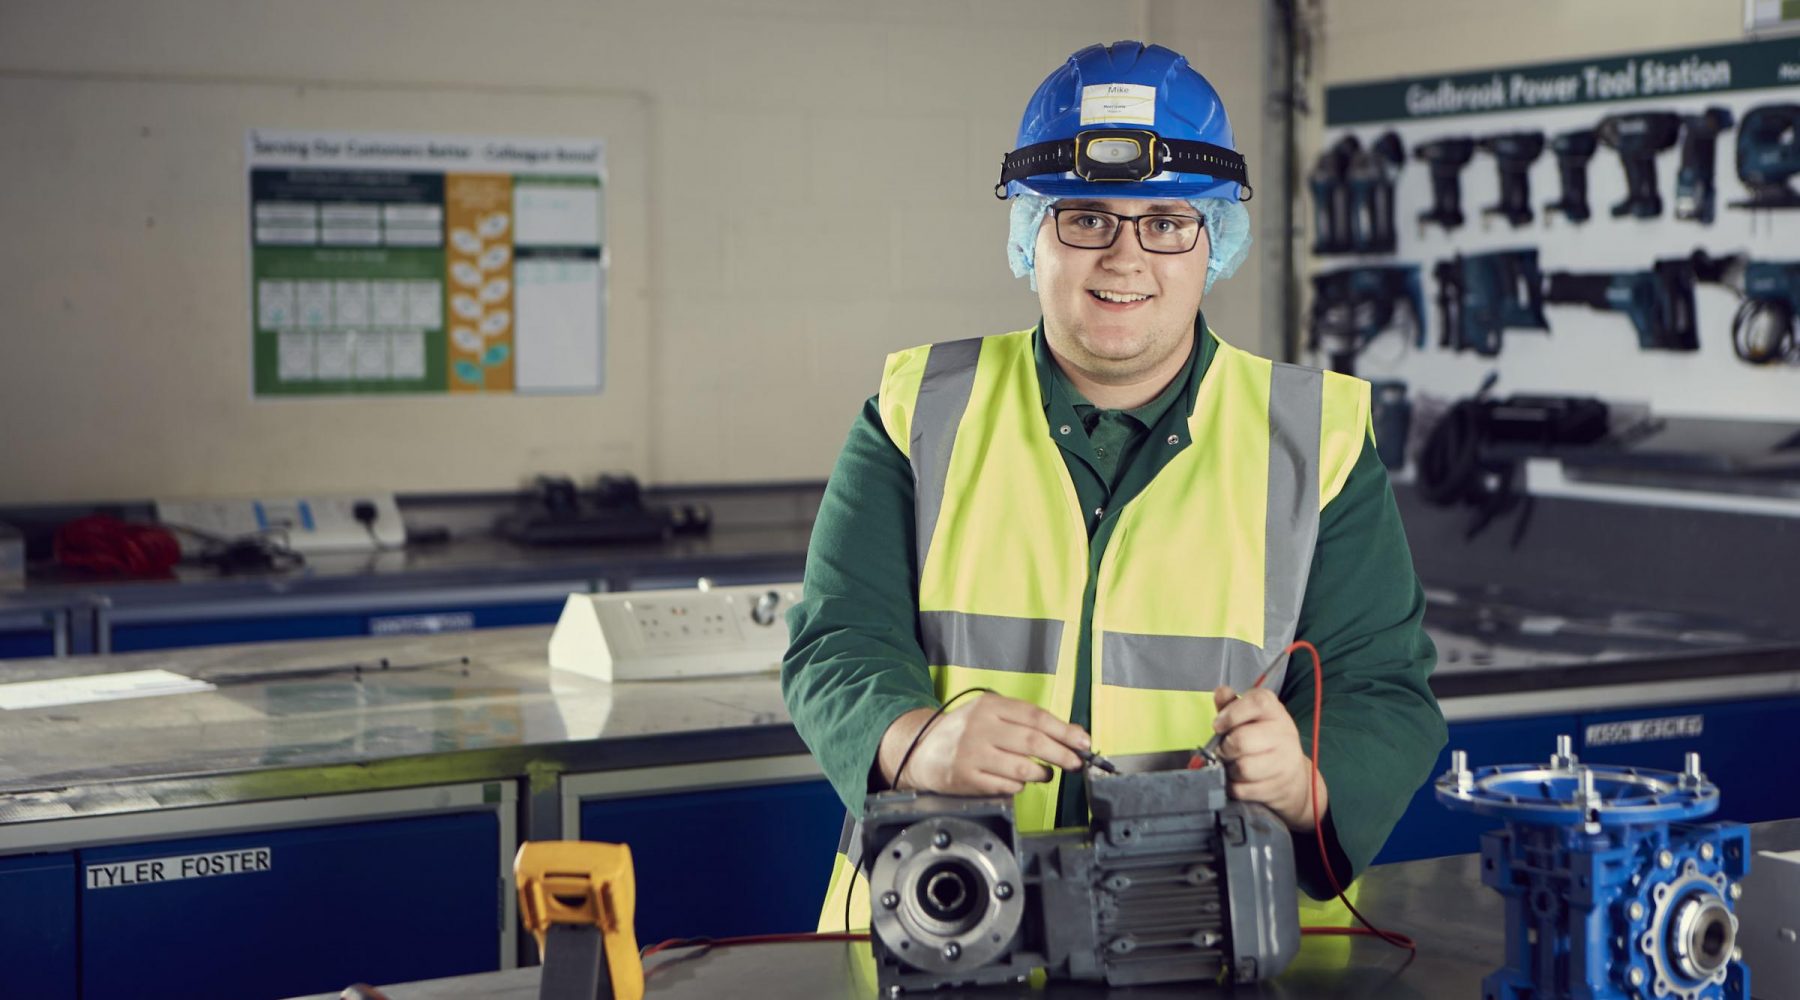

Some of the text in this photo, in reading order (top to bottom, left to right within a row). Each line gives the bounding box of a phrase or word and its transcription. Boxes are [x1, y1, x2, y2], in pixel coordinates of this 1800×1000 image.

[1107, 86, 1129, 94] Mike
[1405, 55, 1731, 115] Gadbrook Power Tool Station
[88, 851, 269, 887] TYLER FOSTER
